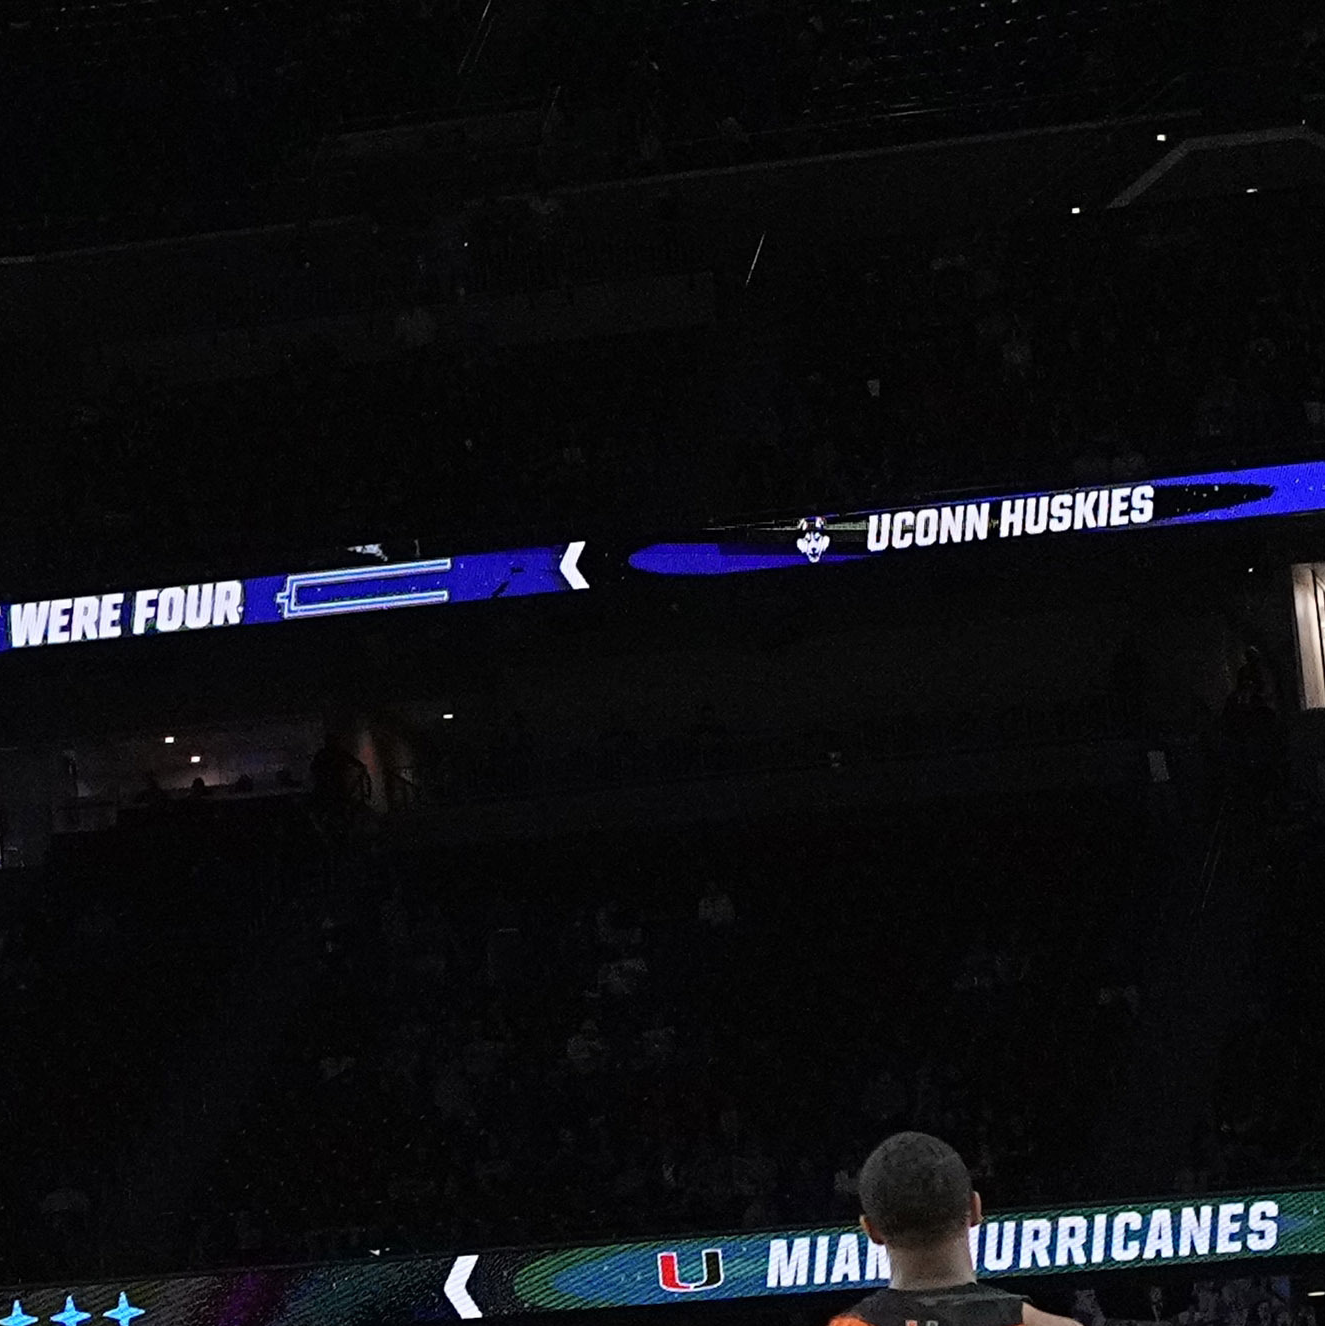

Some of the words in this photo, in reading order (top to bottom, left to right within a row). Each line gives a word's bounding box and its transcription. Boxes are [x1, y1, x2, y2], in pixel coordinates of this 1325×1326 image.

[868, 503, 990, 552] UCONN
[1000, 486, 1155, 537] HUSKIES
[10, 593, 124, 647] WERE
[132, 580, 242, 635] FOUR
[766, 1234, 892, 1288] MIAM
